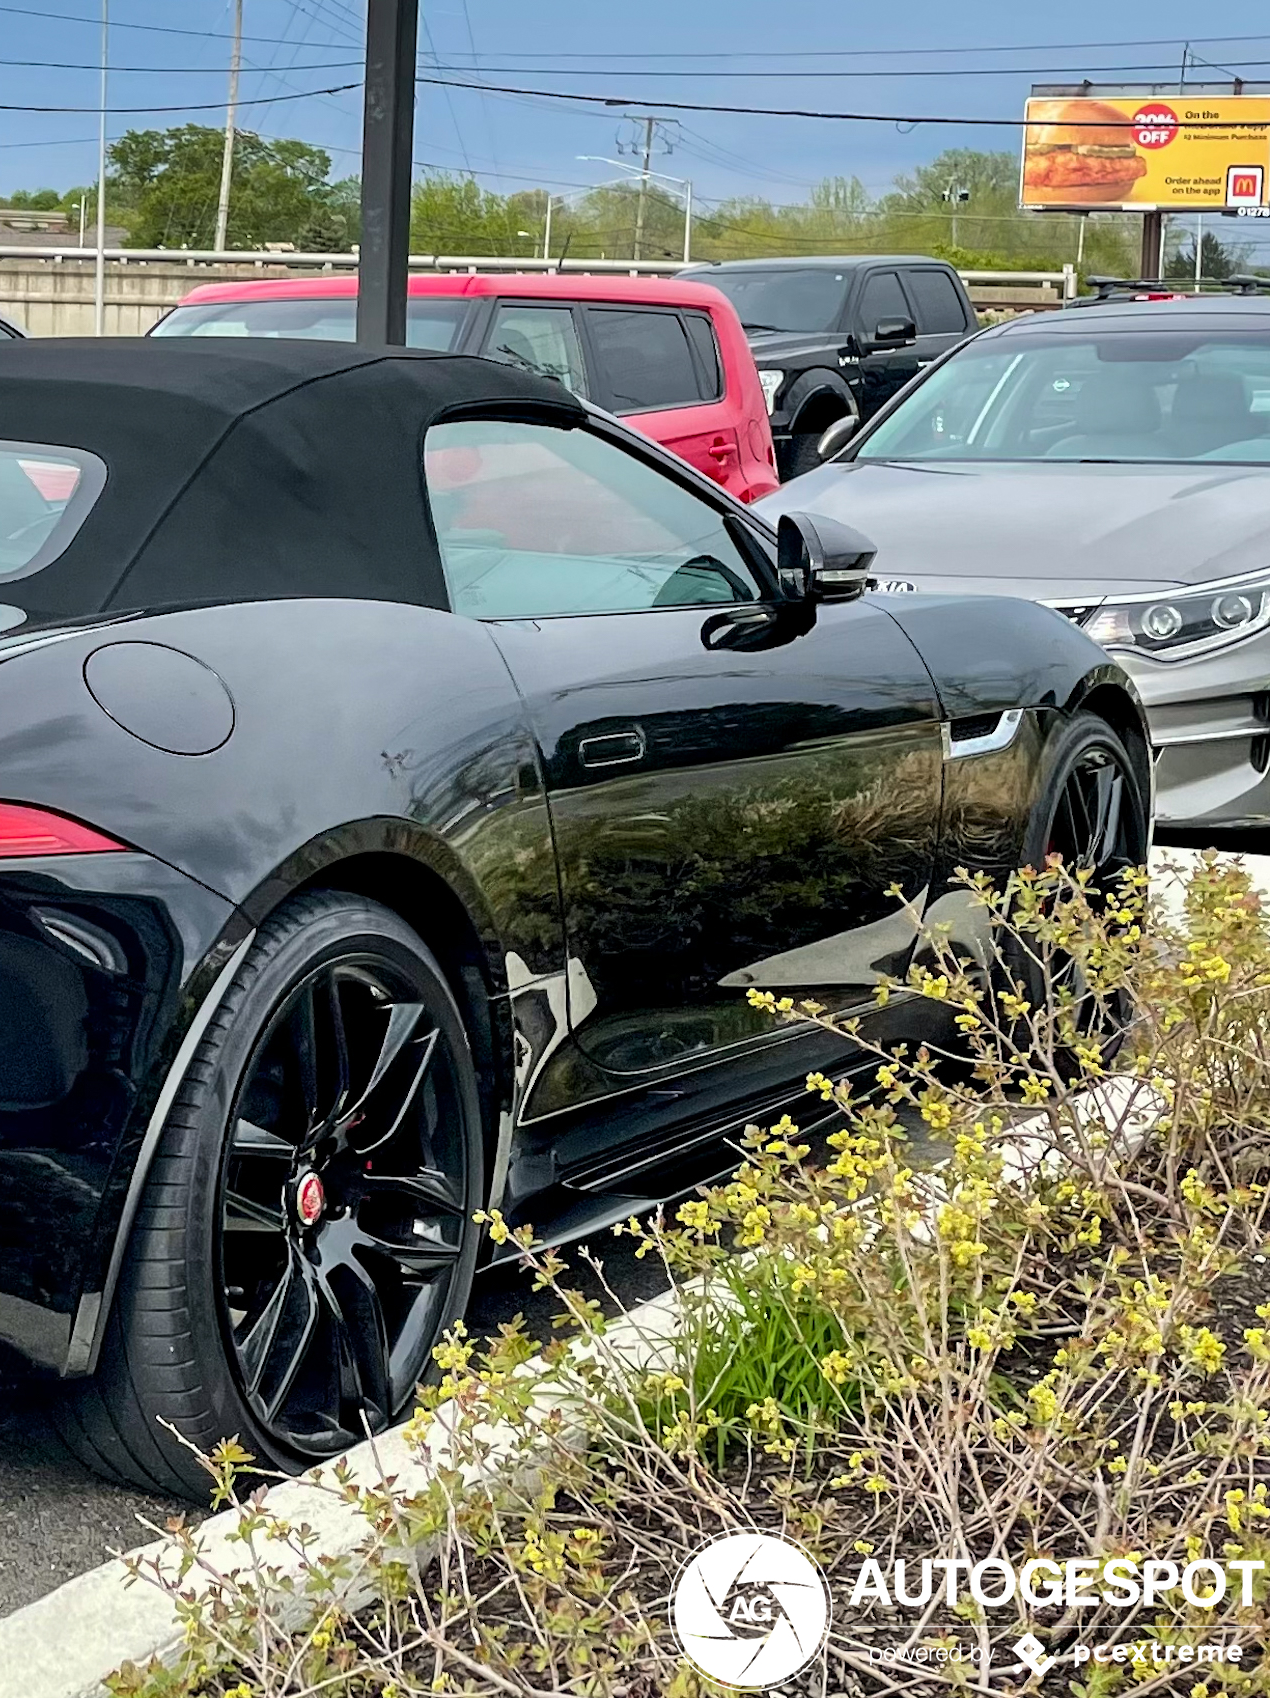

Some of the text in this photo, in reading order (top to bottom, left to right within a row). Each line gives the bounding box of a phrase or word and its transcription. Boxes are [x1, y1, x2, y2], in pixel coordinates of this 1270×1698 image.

[1185, 110, 1220, 119] On the
[1138, 130, 1170, 144] OFF
[1165, 177, 1222, 185] Order ahead
[1186, 187, 1201, 195] the
[1202, 188, 1221, 196] app
